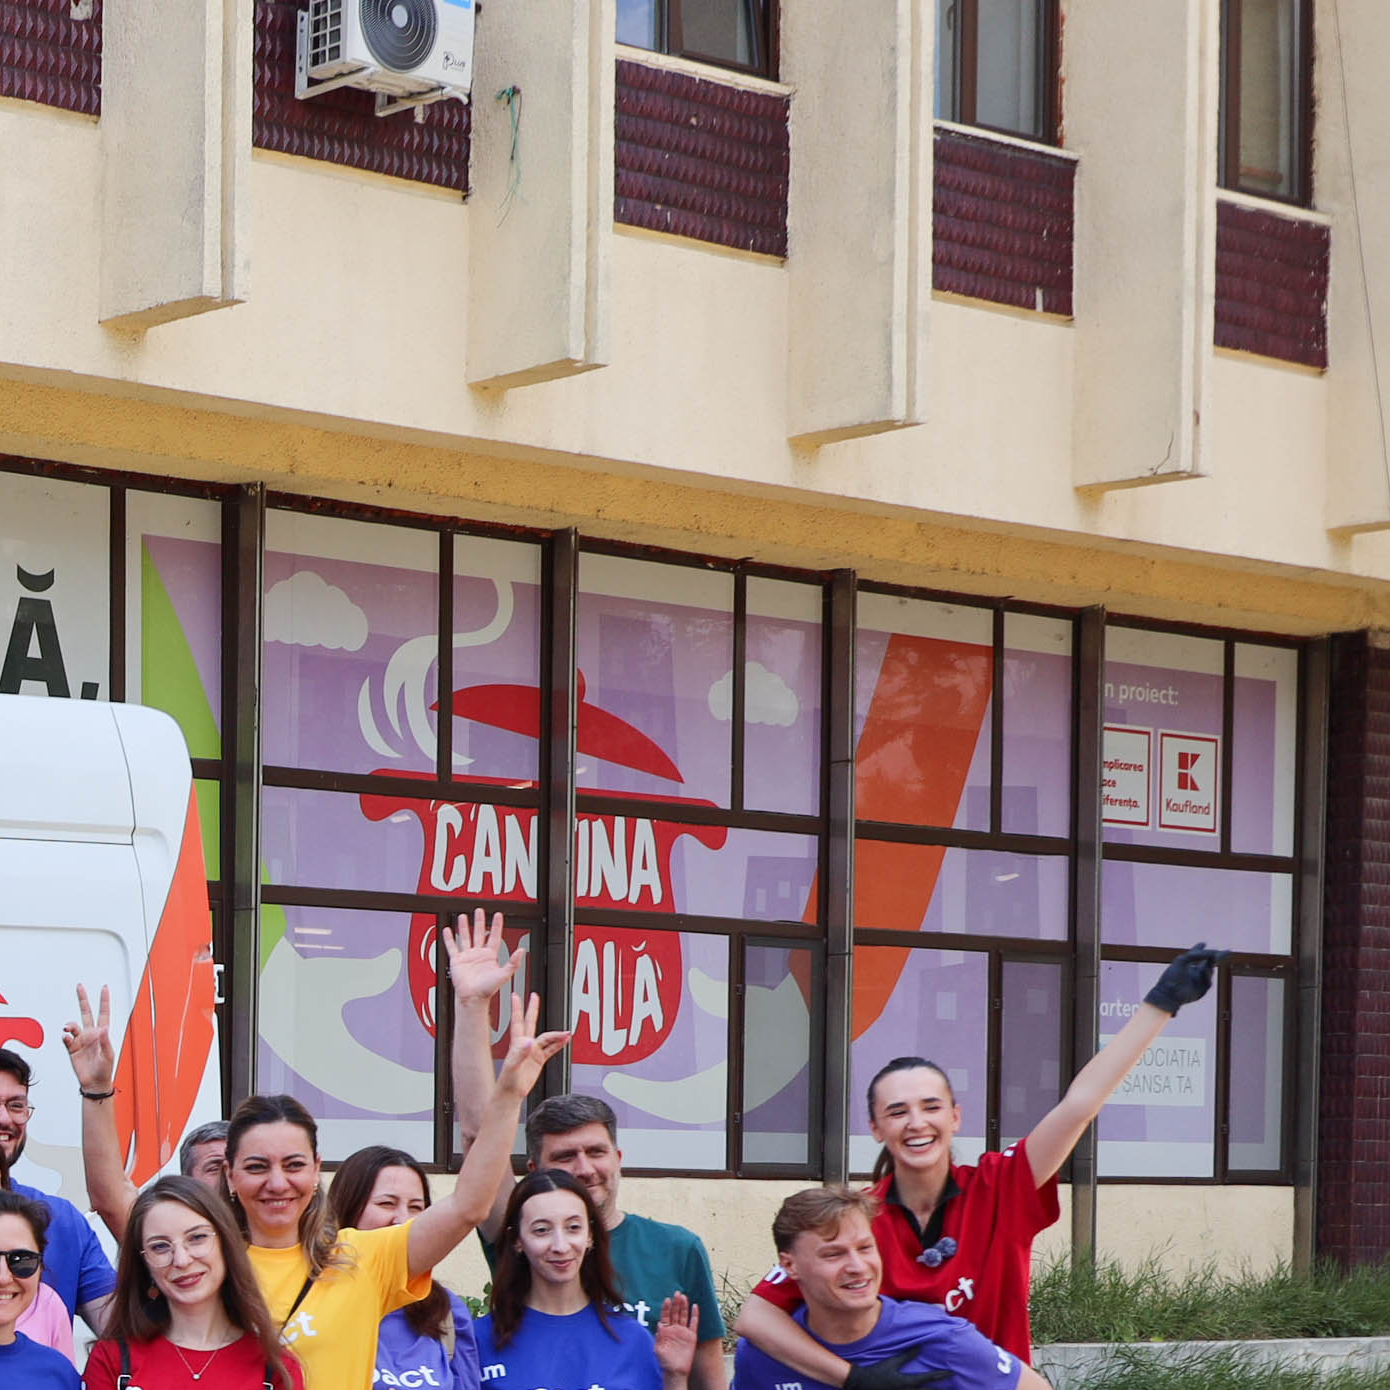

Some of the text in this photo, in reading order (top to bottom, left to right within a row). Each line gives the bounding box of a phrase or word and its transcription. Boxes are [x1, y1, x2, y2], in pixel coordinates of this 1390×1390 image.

[1119, 682, 1180, 705] proiect:
[1103, 758, 1144, 773] mplicarea
[1101, 777, 1117, 788] ace
[1101, 793, 1140, 811] iferența.
[1166, 798, 1211, 816] Kaufland
[430, 803, 663, 905] CANINA
[1176, 1075, 1193, 1095] TA
